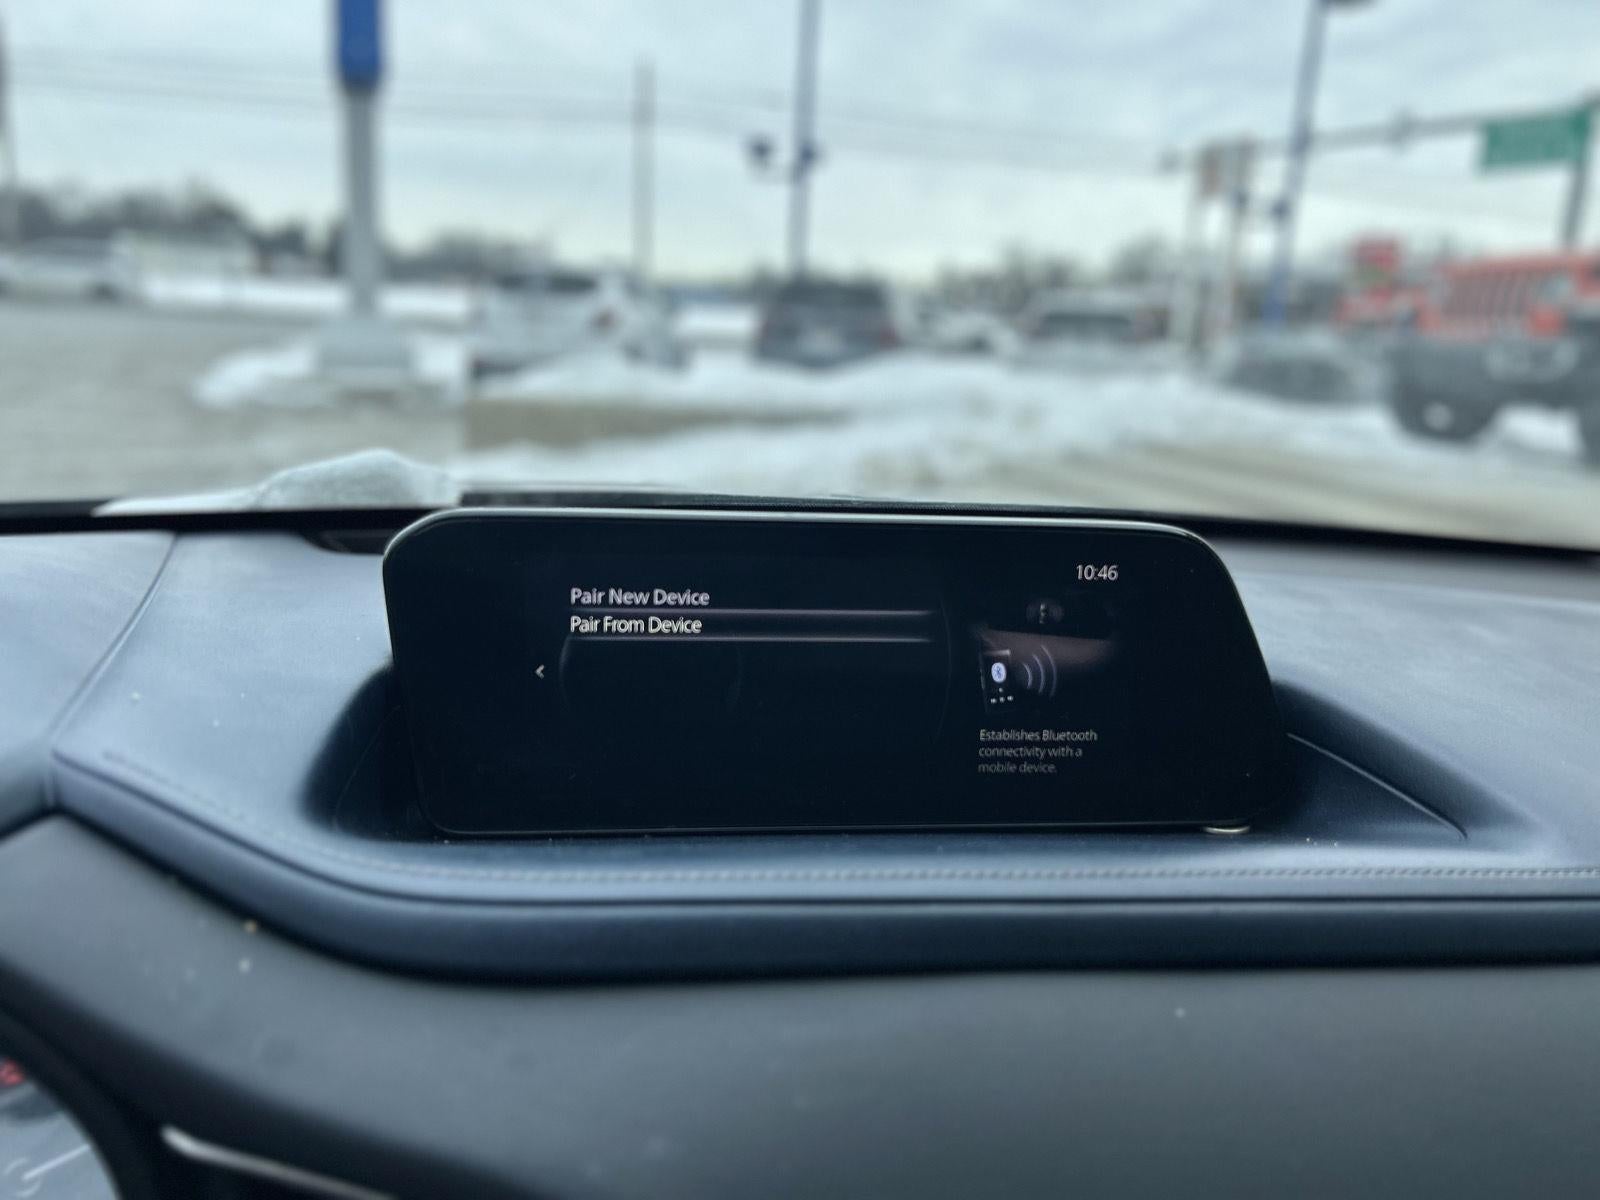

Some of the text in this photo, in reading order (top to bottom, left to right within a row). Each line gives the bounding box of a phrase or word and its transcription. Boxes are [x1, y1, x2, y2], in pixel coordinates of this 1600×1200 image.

[1076, 564, 1119, 581] 10:46
[570, 588, 710, 606] Pair New Device
[569, 615, 703, 634] Pair From Device
[979, 729, 1098, 742] Establishes Bluetooth
[978, 745, 1083, 760] connectivity with a
[978, 761, 1058, 774] mobile device.
